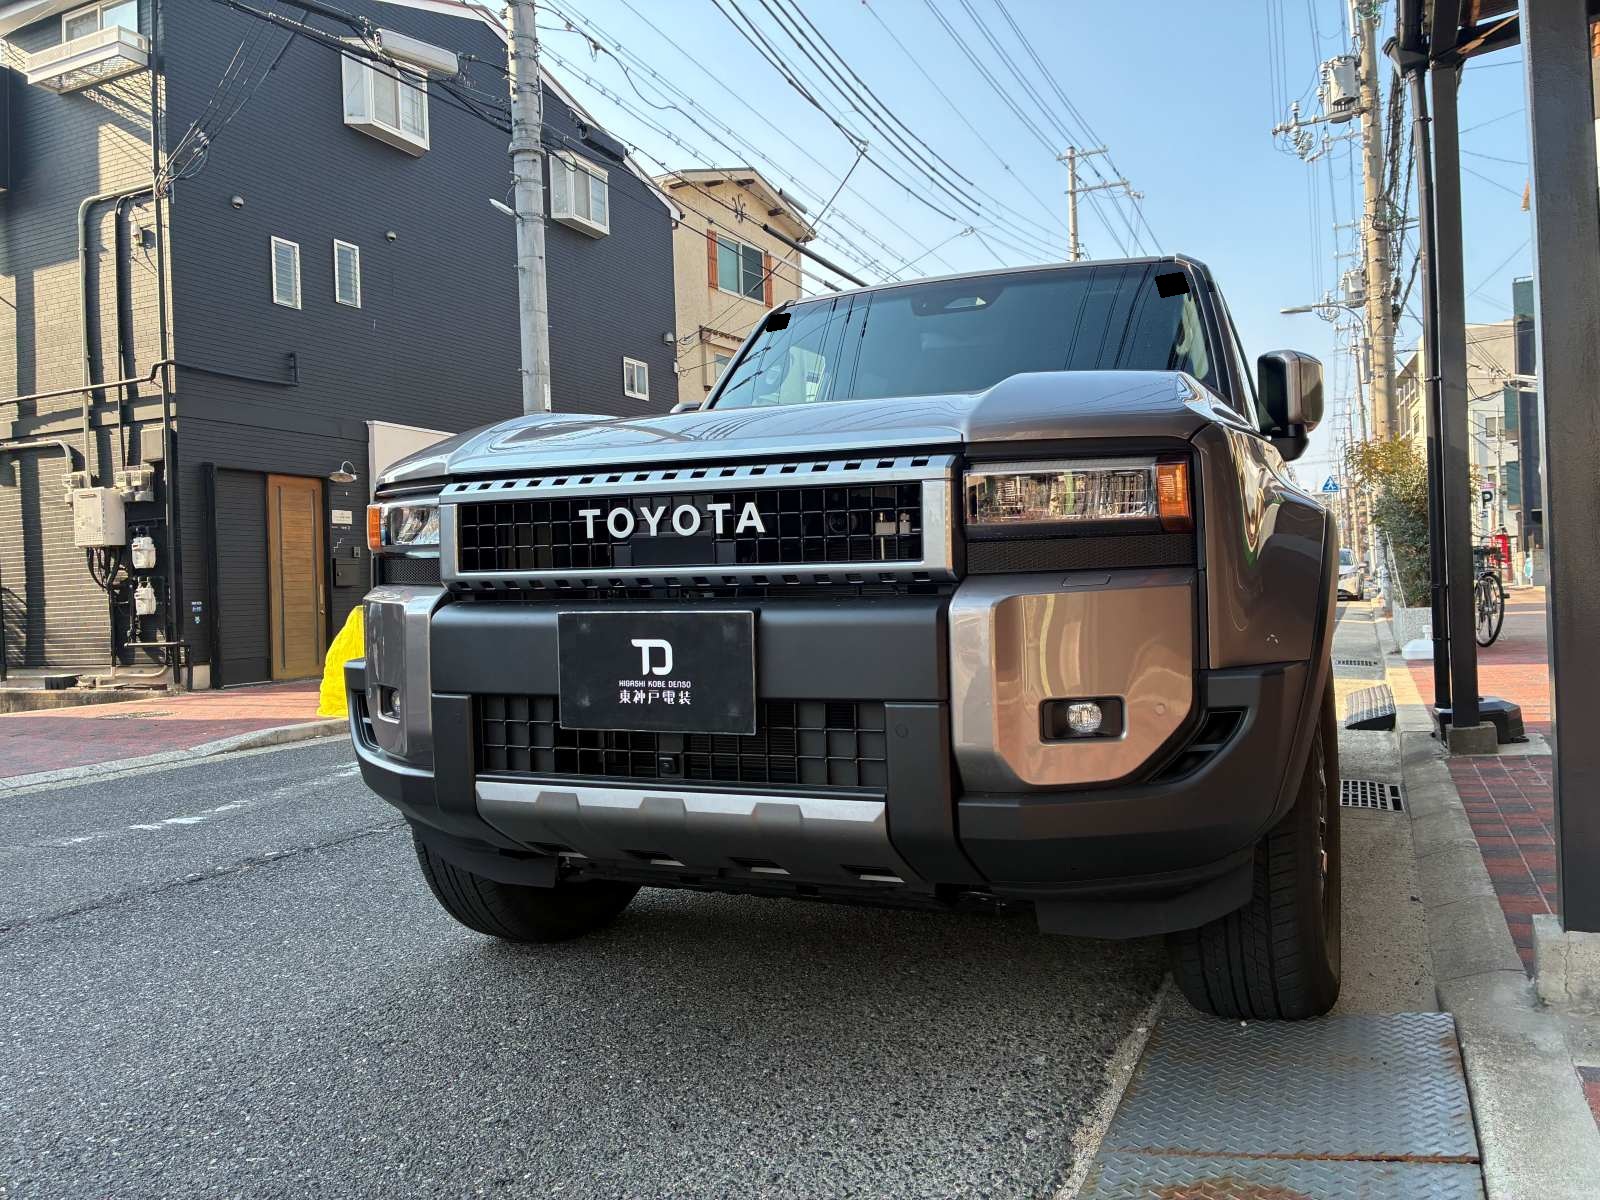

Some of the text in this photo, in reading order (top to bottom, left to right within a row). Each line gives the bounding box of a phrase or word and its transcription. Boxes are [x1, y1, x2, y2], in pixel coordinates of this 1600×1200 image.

[1481, 491, 1493, 509] P
[578, 501, 766, 539] TOYOTA
[618, 679, 646, 688] HIGASHI
[648, 680, 666, 688] KOBE
[618, 689, 692, 705] 東神戸電装
